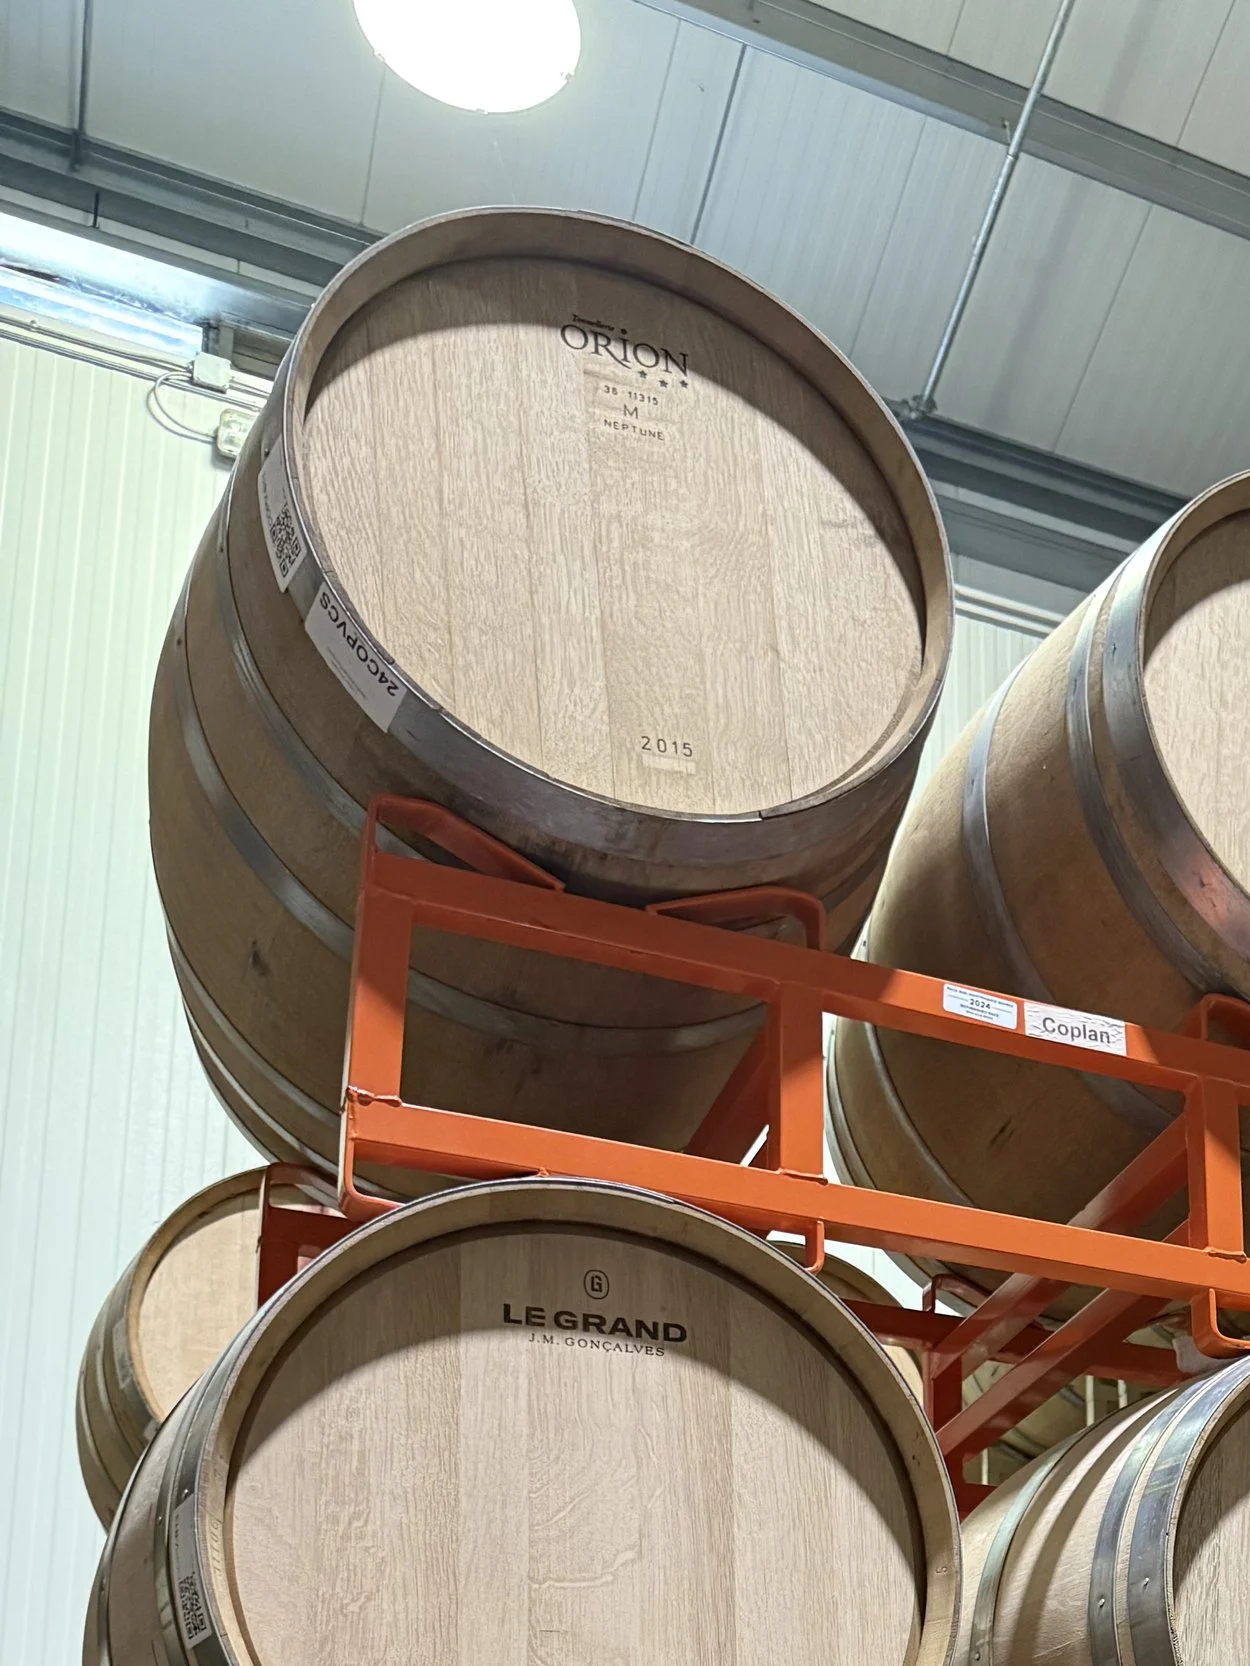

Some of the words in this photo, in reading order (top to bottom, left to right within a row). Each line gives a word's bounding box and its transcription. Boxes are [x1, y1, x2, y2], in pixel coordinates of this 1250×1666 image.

[560, 324, 689, 377] ORION
[623, 404, 639, 419] M
[603, 419, 664, 441] NEPTUNE
[319, 591, 399, 697] 24COPVCS
[641, 735, 693, 757] 2015
[970, 998, 991, 1010] 2024
[1042, 1017, 1111, 1044] Coplan
[503, 1303, 546, 1327] LE
[553, 1310, 687, 1343] GRAND
[528, 1333, 560, 1346] J.M.
[564, 1337, 665, 1357] GONÇALVES
